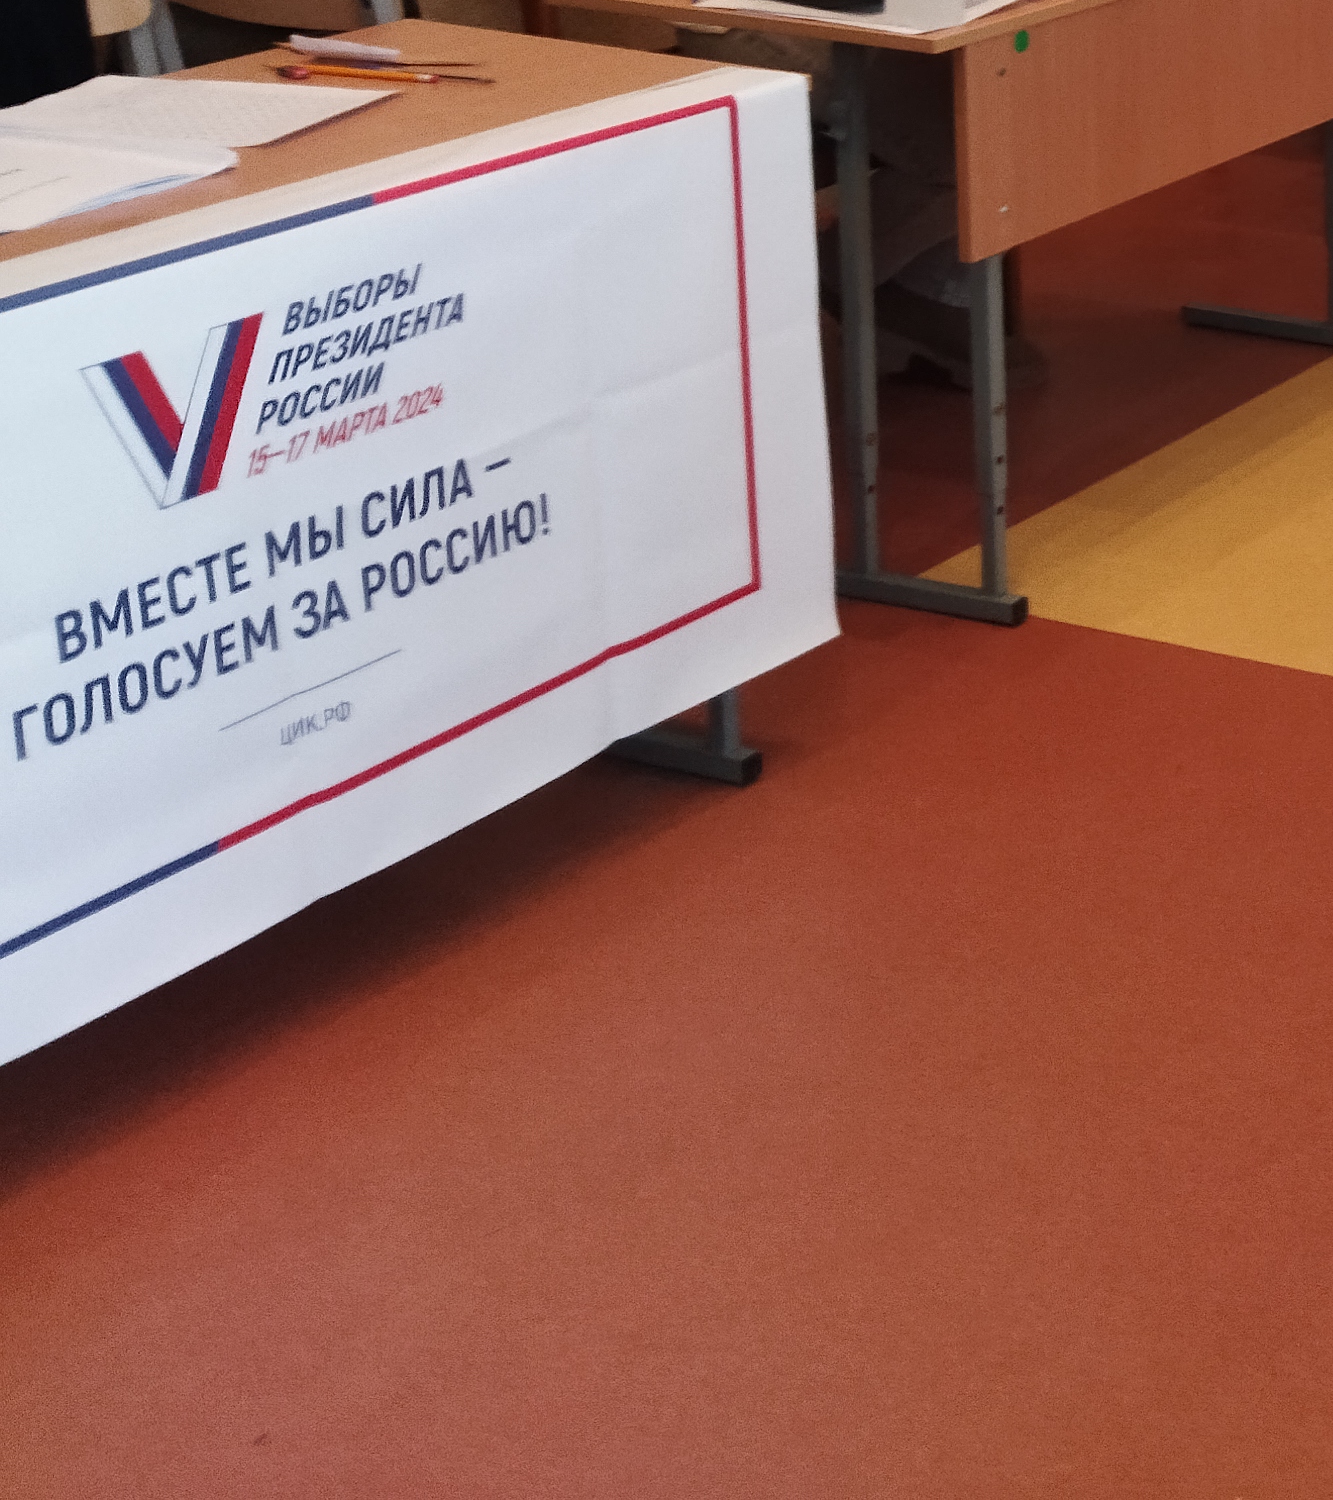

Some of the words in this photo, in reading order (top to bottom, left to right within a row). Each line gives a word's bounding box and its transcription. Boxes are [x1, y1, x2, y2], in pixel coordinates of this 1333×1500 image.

[281, 262, 423, 337] ВЫБОРЫ
[267, 292, 465, 385] ПРЕЗИДЕНТА
[256, 361, 386, 435] РОССИИ
[313, 402, 389, 454] МАРТА
[392, 383, 444, 426] 2024
[54, 541, 253, 663] ВМЕСТЕ
[264, 505, 346, 577] МЫ
[361, 458, 475, 539] СИЛА
[12, 603, 280, 762] ГОЛОСУЕМ
[291, 580, 351, 640] ЗА
[361, 492, 552, 612] РОССИЮ!
[280, 700, 351, 746] ЦИК.РФ
